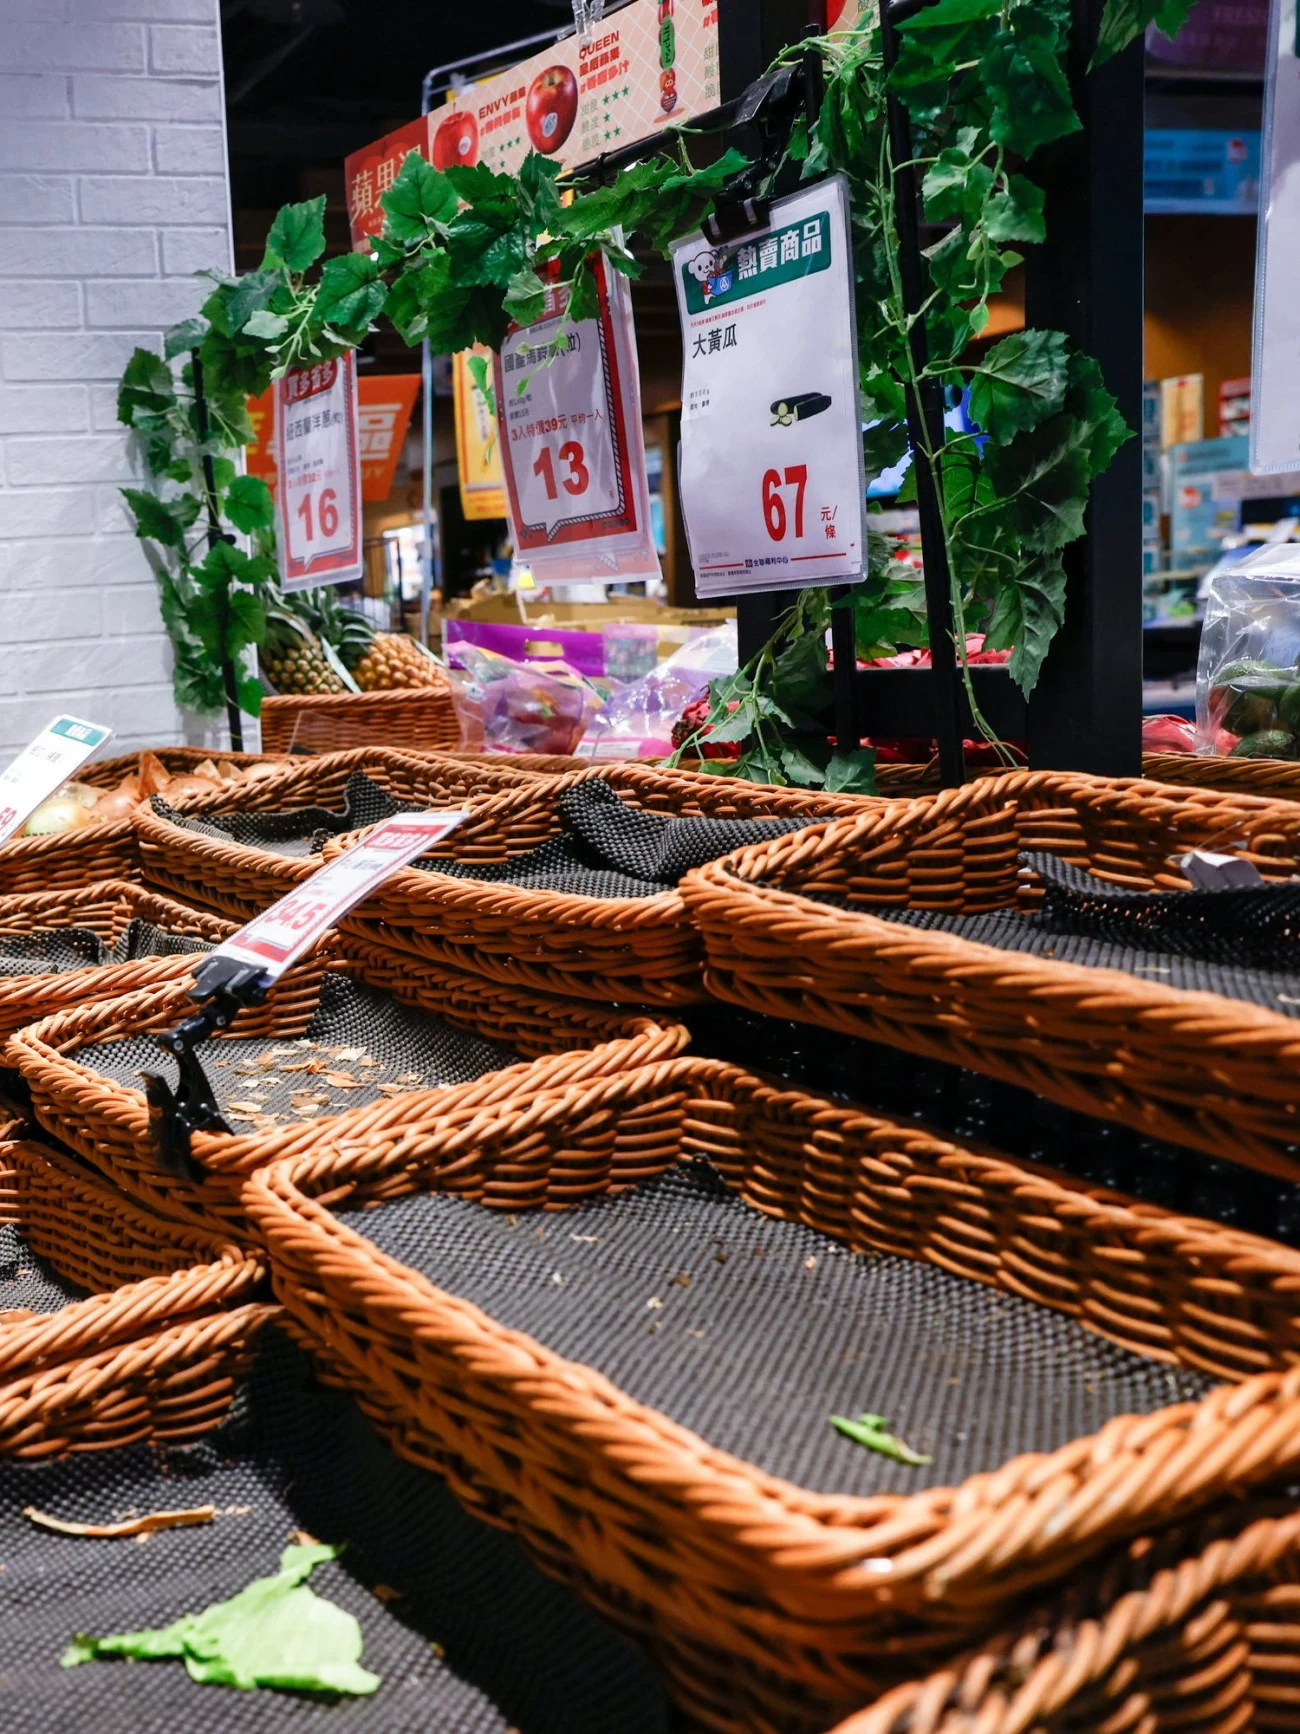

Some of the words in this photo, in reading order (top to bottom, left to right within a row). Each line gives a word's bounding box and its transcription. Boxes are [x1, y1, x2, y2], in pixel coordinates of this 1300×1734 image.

[579, 30, 619, 60] QUEEN
[736, 219, 822, 281] 熱賣商品
[692, 323, 738, 359] 大黃瓜
[533, 441, 589, 500] 13
[298, 488, 339, 541] 16
[762, 464, 808, 542] 67
